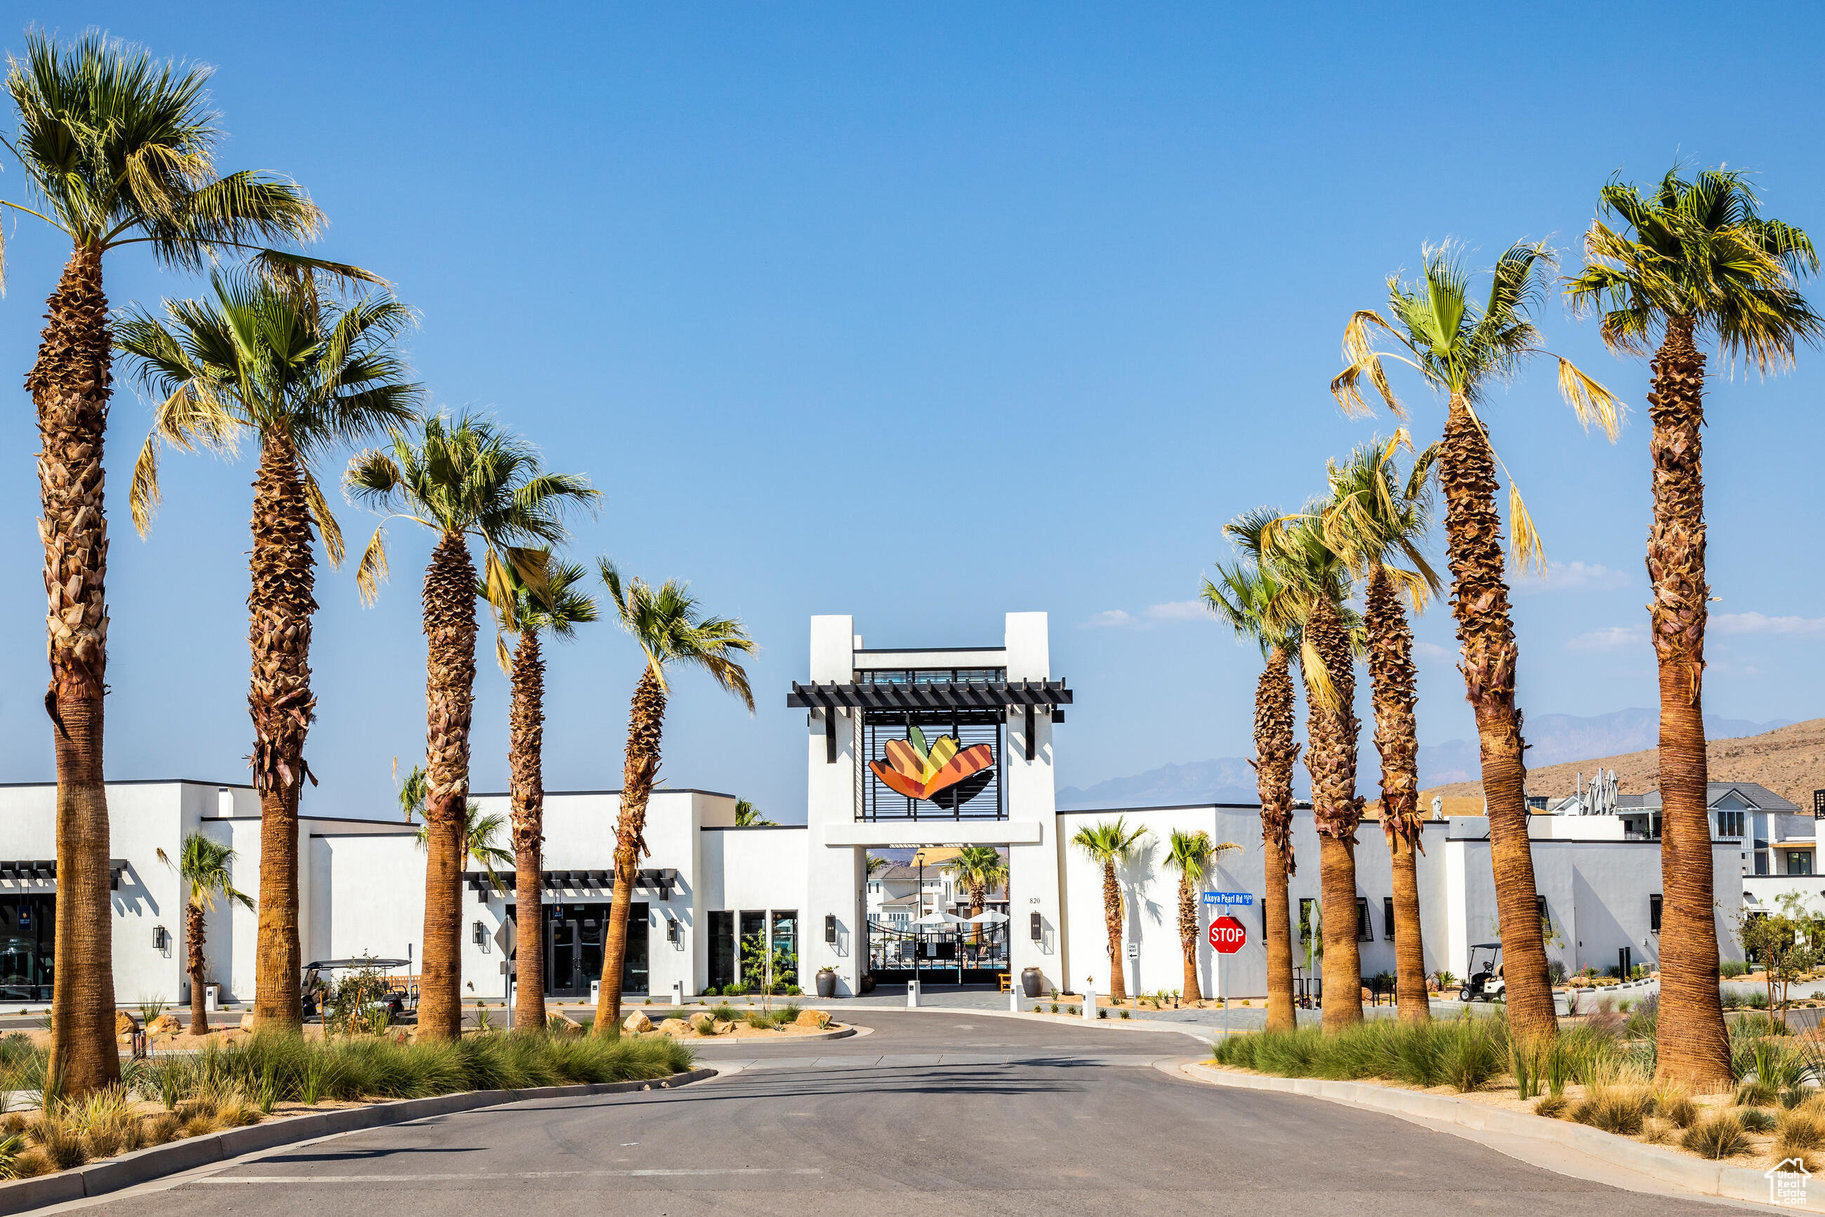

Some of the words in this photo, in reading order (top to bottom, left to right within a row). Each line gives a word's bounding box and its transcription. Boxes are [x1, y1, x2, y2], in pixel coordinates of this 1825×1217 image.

[1204, 894, 1220, 903] Akoya
[1221, 894, 1235, 903] Pearl
[1236, 894, 1243, 903] Rd
[1211, 927, 1244, 942] STOP
